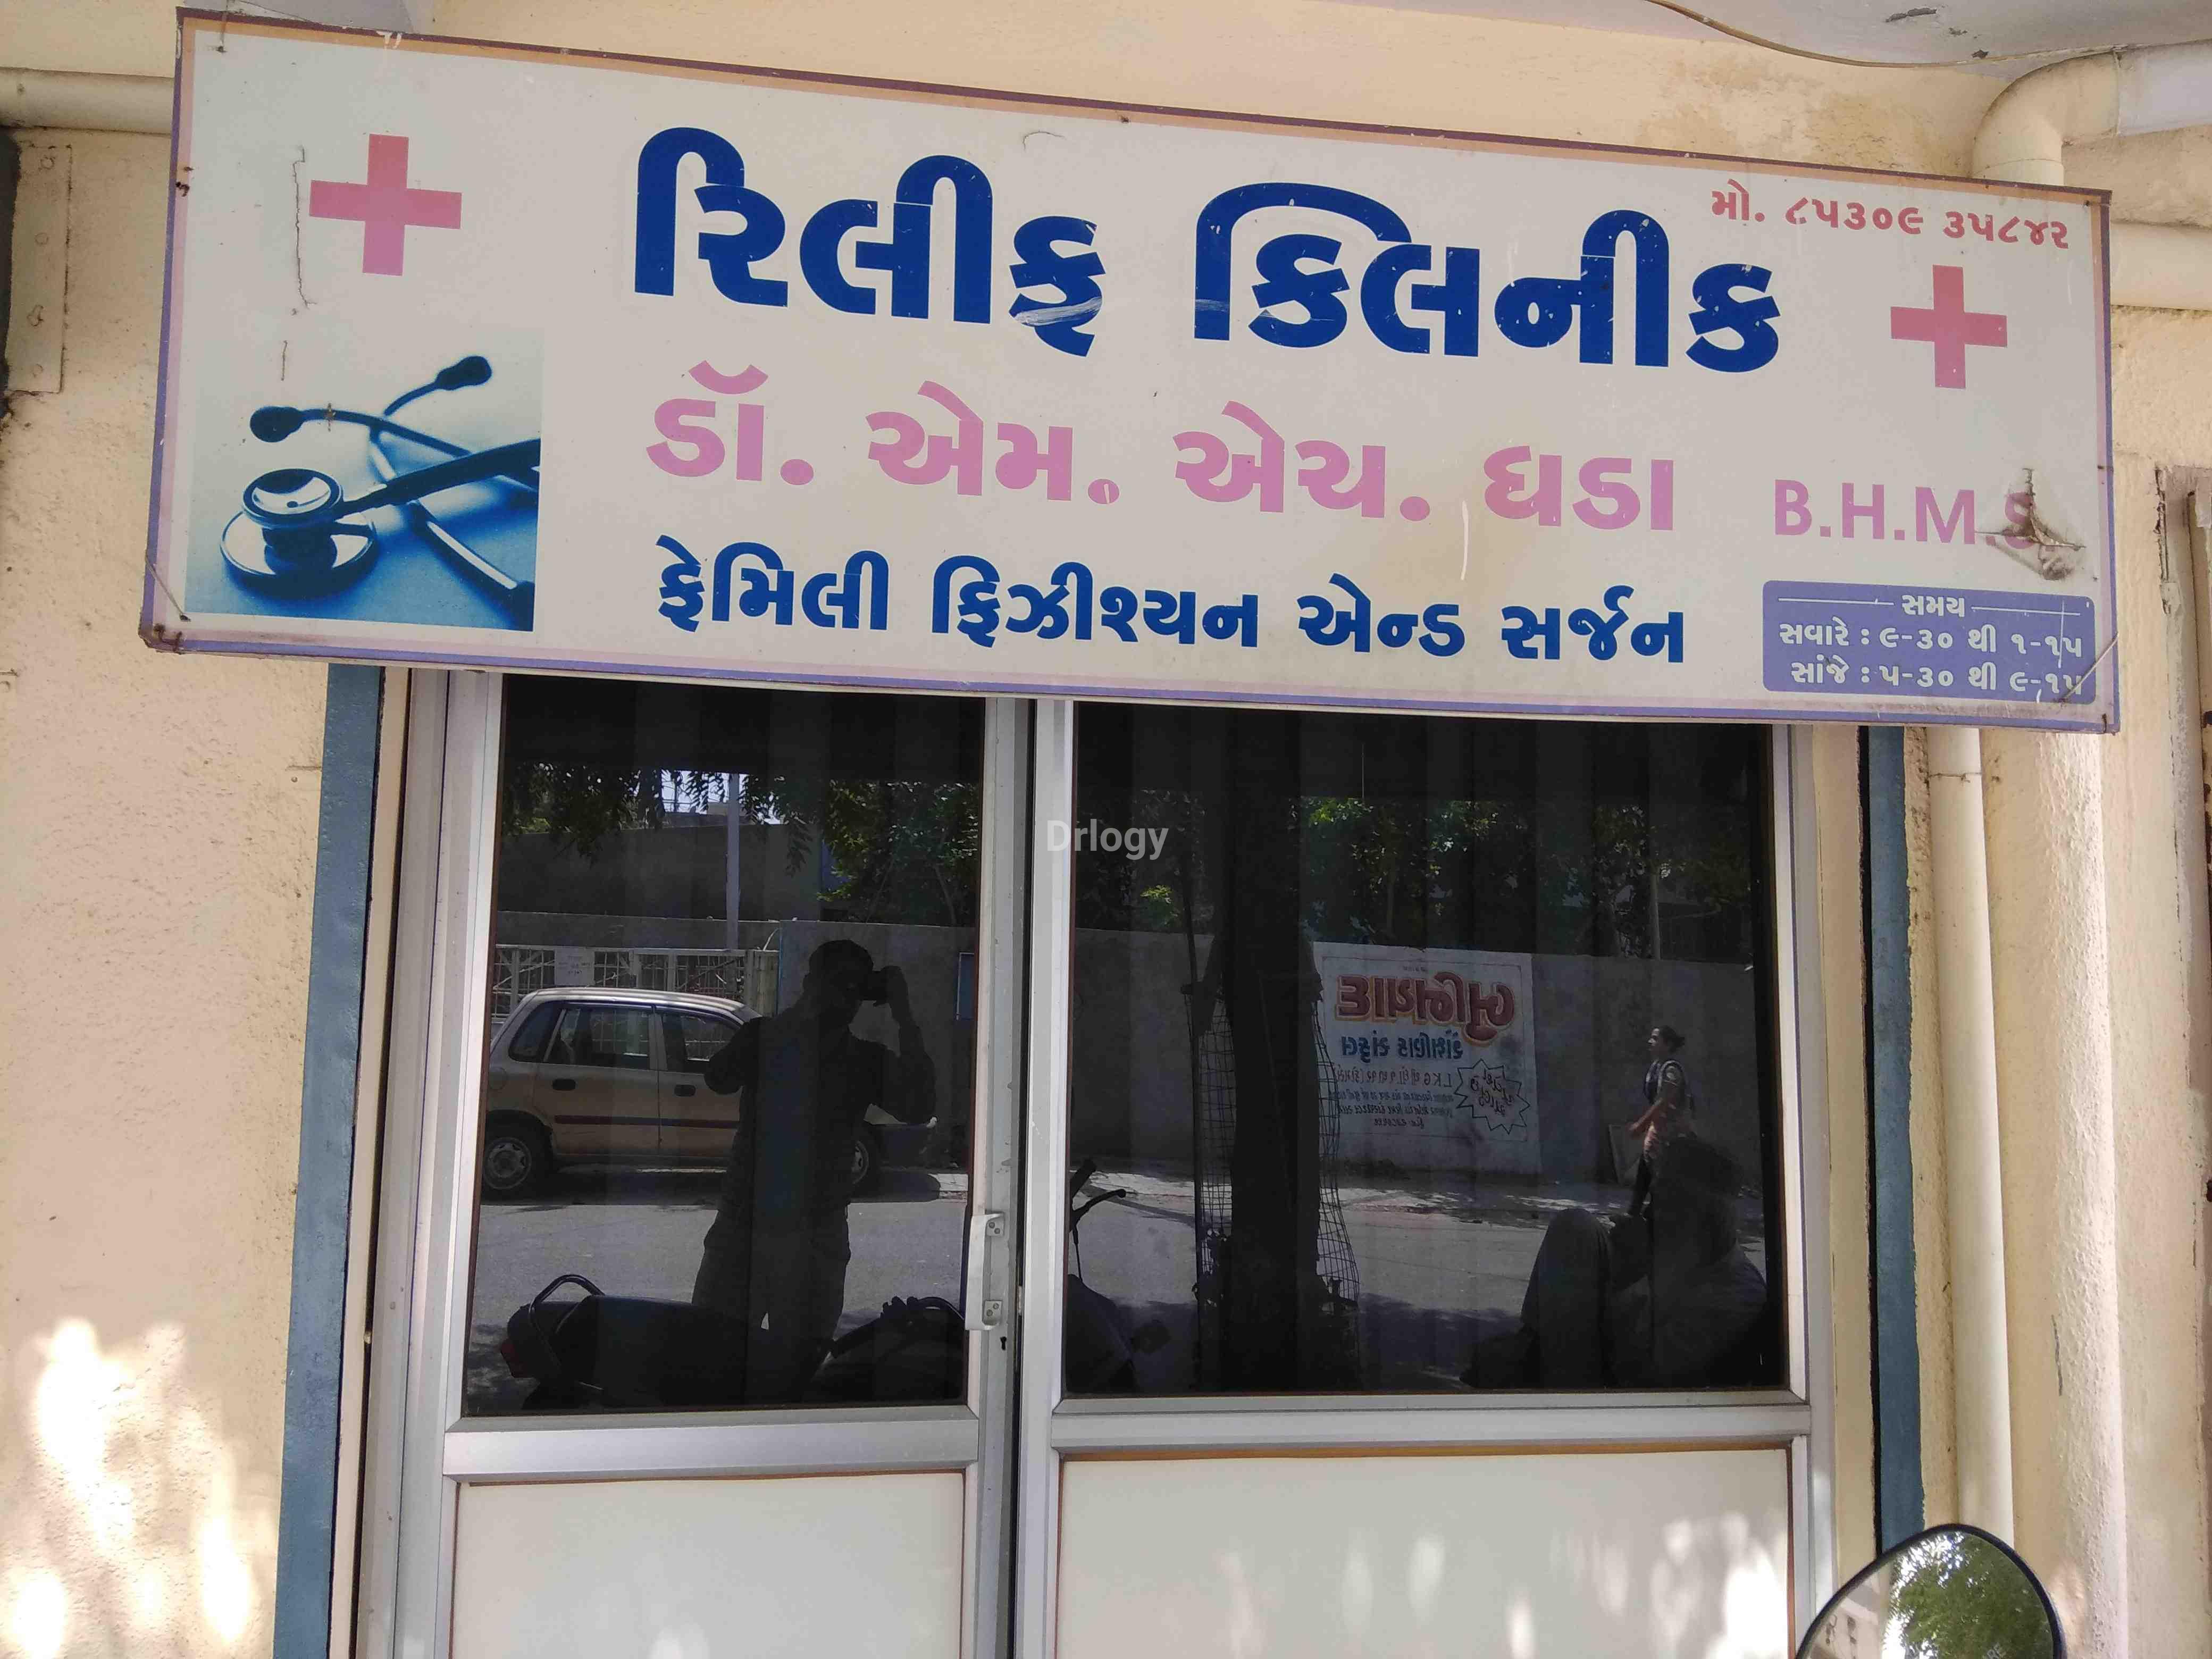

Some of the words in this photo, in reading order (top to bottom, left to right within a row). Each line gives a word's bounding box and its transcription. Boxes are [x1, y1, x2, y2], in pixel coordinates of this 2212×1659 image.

[635, 127, 1105, 357] રિલીફ
[1712, 179, 1765, 222] મો.
[1786, 198, 1923, 234] ૮૫૩૦૯
[1943, 211, 2069, 249] ૩૫૮૪૨
[865, 380, 1120, 504] એમ.
[1172, 400, 1430, 522] એચ.
[656, 535, 889, 632] ફેમિલી
[1297, 573, 1465, 657] એન્ડ
[1501, 585, 1684, 663] સર્જન
[1901, 594, 1965, 617] સમય
[1779, 616, 1849, 646] સવારે
[1967, 624, 1997, 653] થી
[1790, 653, 1850, 684] સાંજે
[1968, 661, 1997, 691] થી
